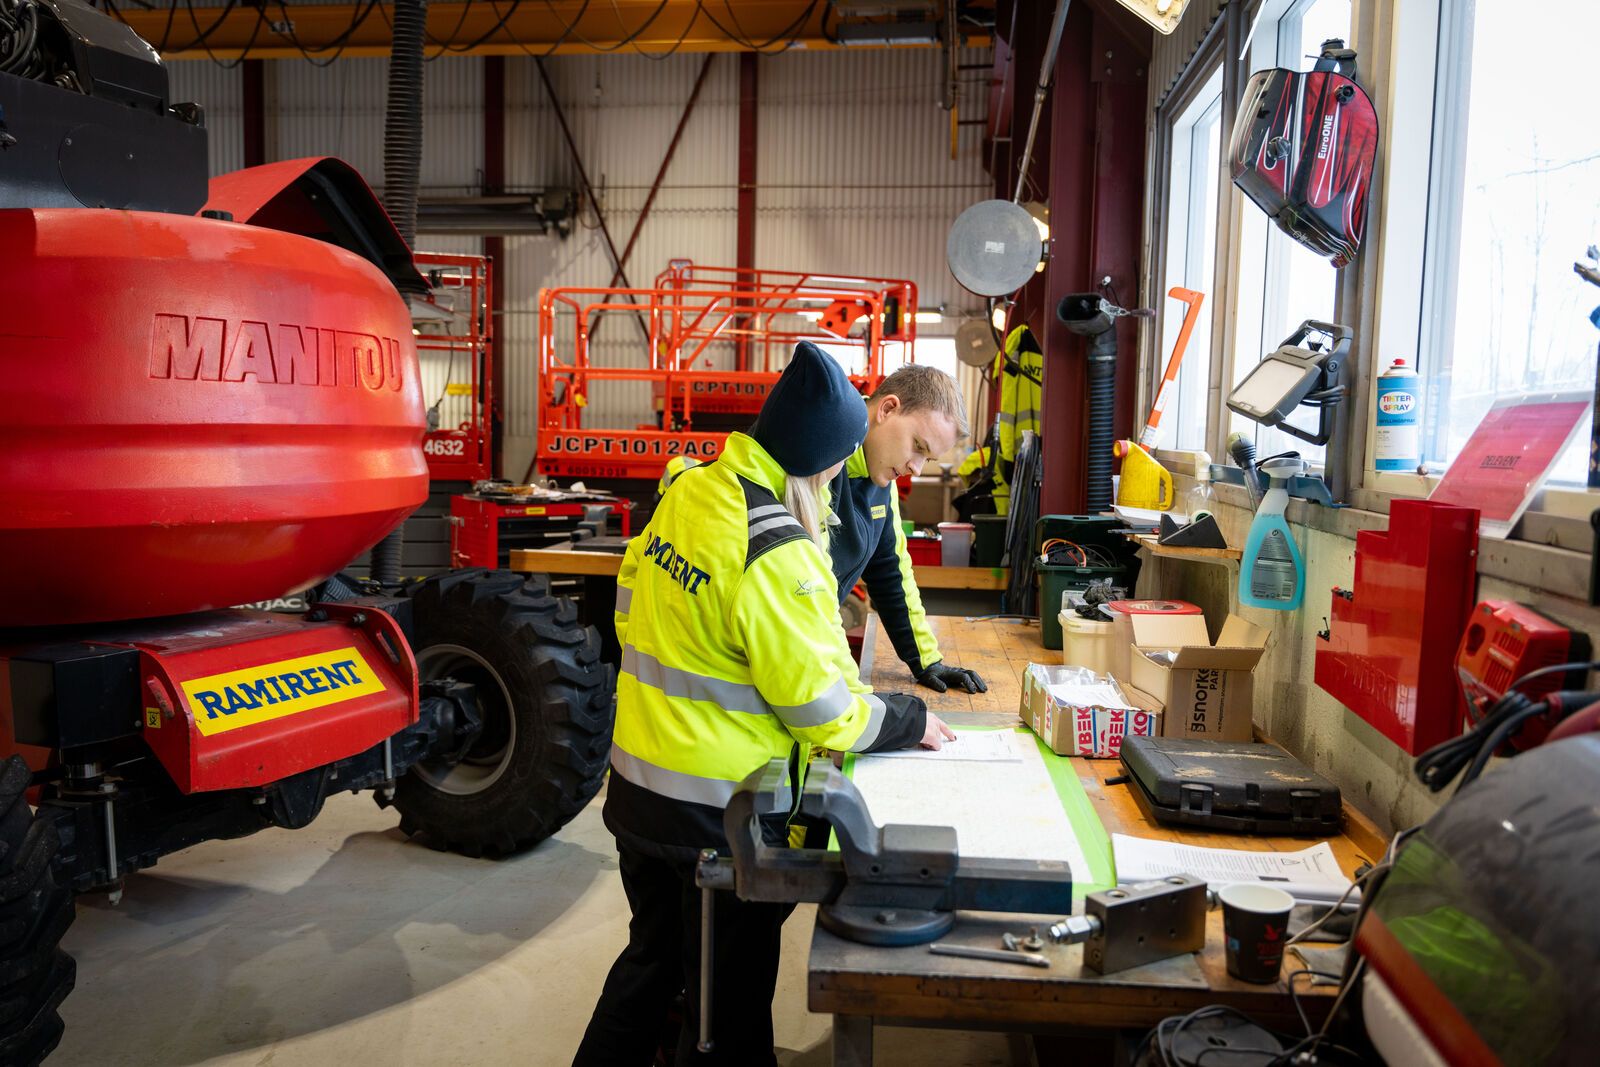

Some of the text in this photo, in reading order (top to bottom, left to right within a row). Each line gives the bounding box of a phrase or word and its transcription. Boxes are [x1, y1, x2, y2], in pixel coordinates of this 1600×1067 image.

[1318, 115, 1333, 158] EuroONE
[150, 313, 402, 393] MANITOU
[1383, 404, 1410, 412] SPRAY
[423, 439, 464, 456] 4632
[549, 437, 717, 456] JCPT1012AC
[193, 660, 364, 720] RAMIRENT
